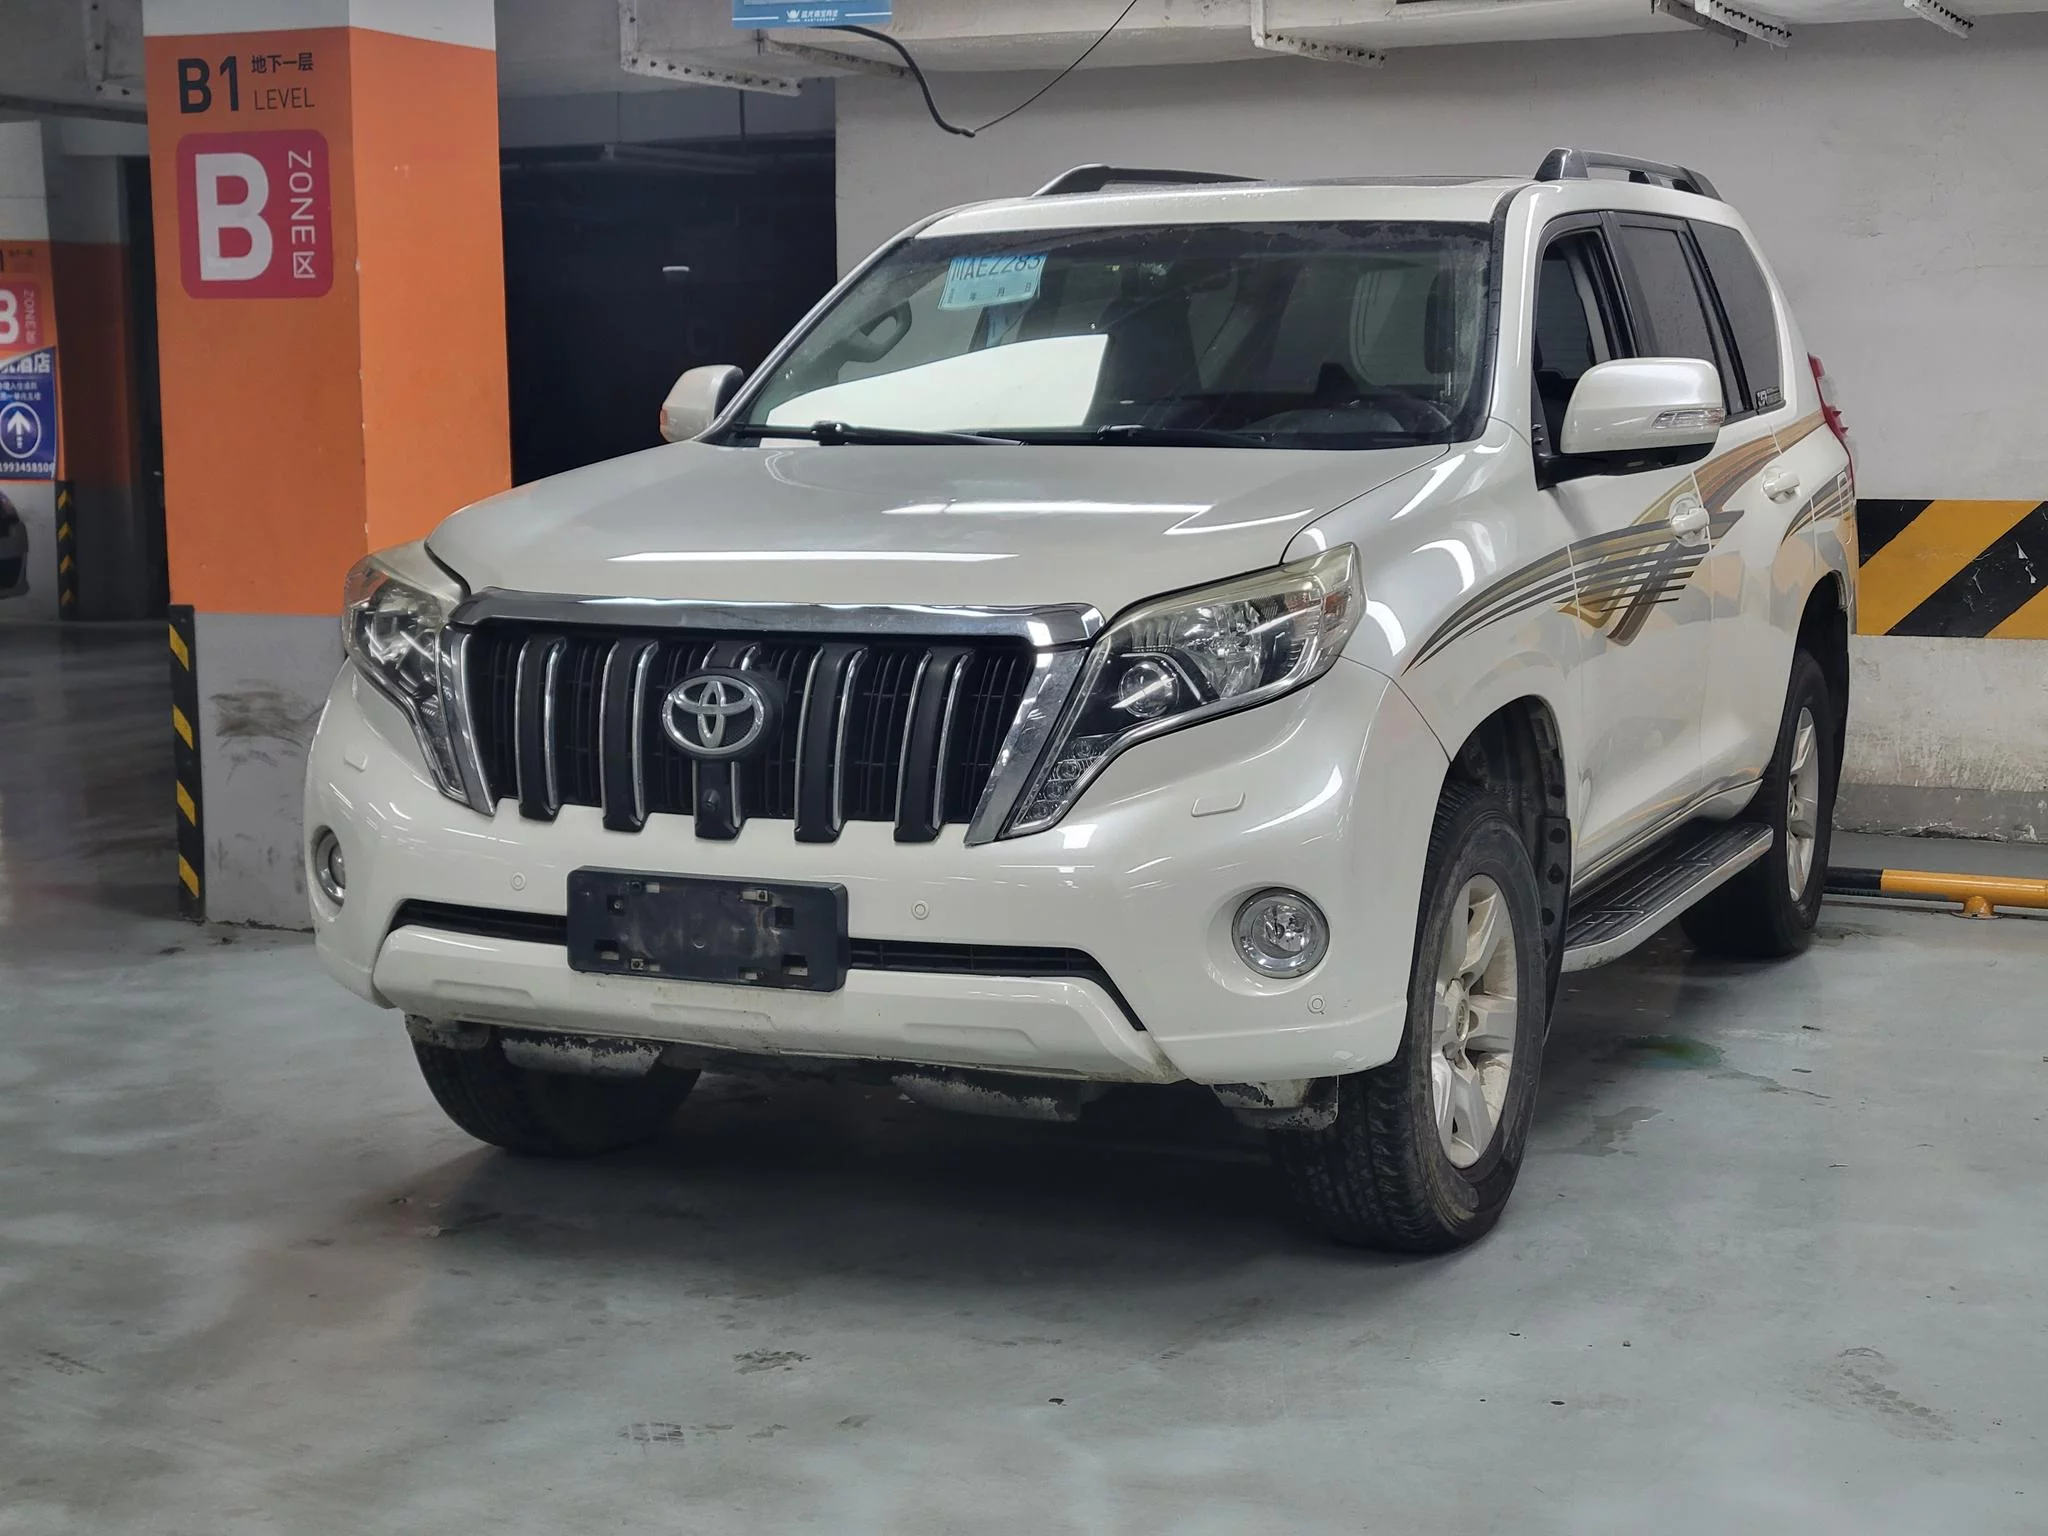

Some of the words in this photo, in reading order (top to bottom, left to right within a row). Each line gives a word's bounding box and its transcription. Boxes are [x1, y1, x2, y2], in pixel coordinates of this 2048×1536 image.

[251, 52, 314, 74] 地下一层
[178, 55, 239, 114] B1
[254, 87, 315, 111] LEVEL
[195, 152, 273, 281] B
